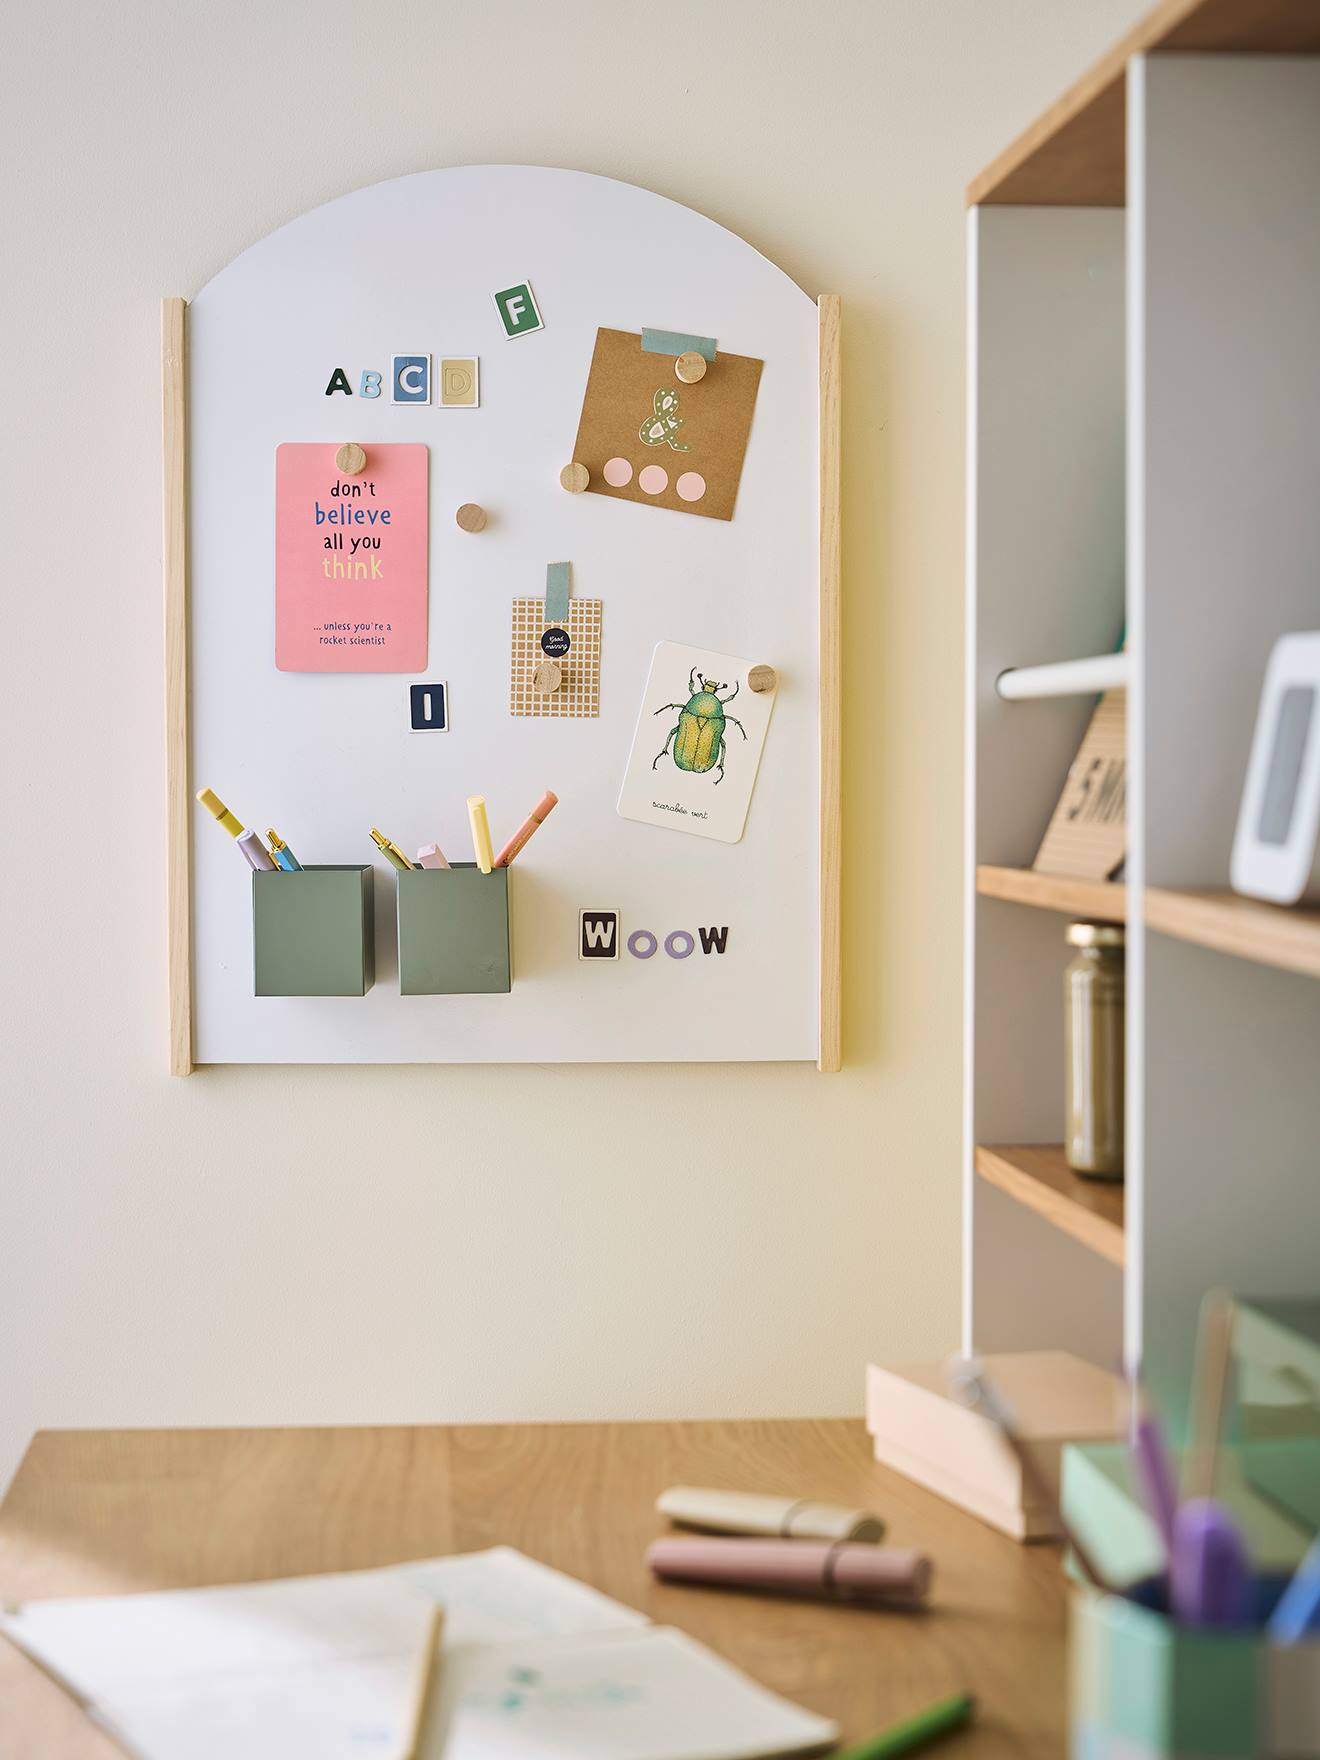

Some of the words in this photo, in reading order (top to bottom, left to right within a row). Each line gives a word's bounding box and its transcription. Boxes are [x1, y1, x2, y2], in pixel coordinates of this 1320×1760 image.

[504, 294, 527, 326] F
[330, 479, 376, 498] don't
[315, 501, 391, 525] believe
[323, 532, 343, 550] all
[350, 537, 381, 555] you
[322, 553, 384, 580] think
[353, 622, 384, 633] you're
[386, 623, 392, 631] a
[319, 635, 347, 645] rocket
[350, 635, 386, 645] scientist
